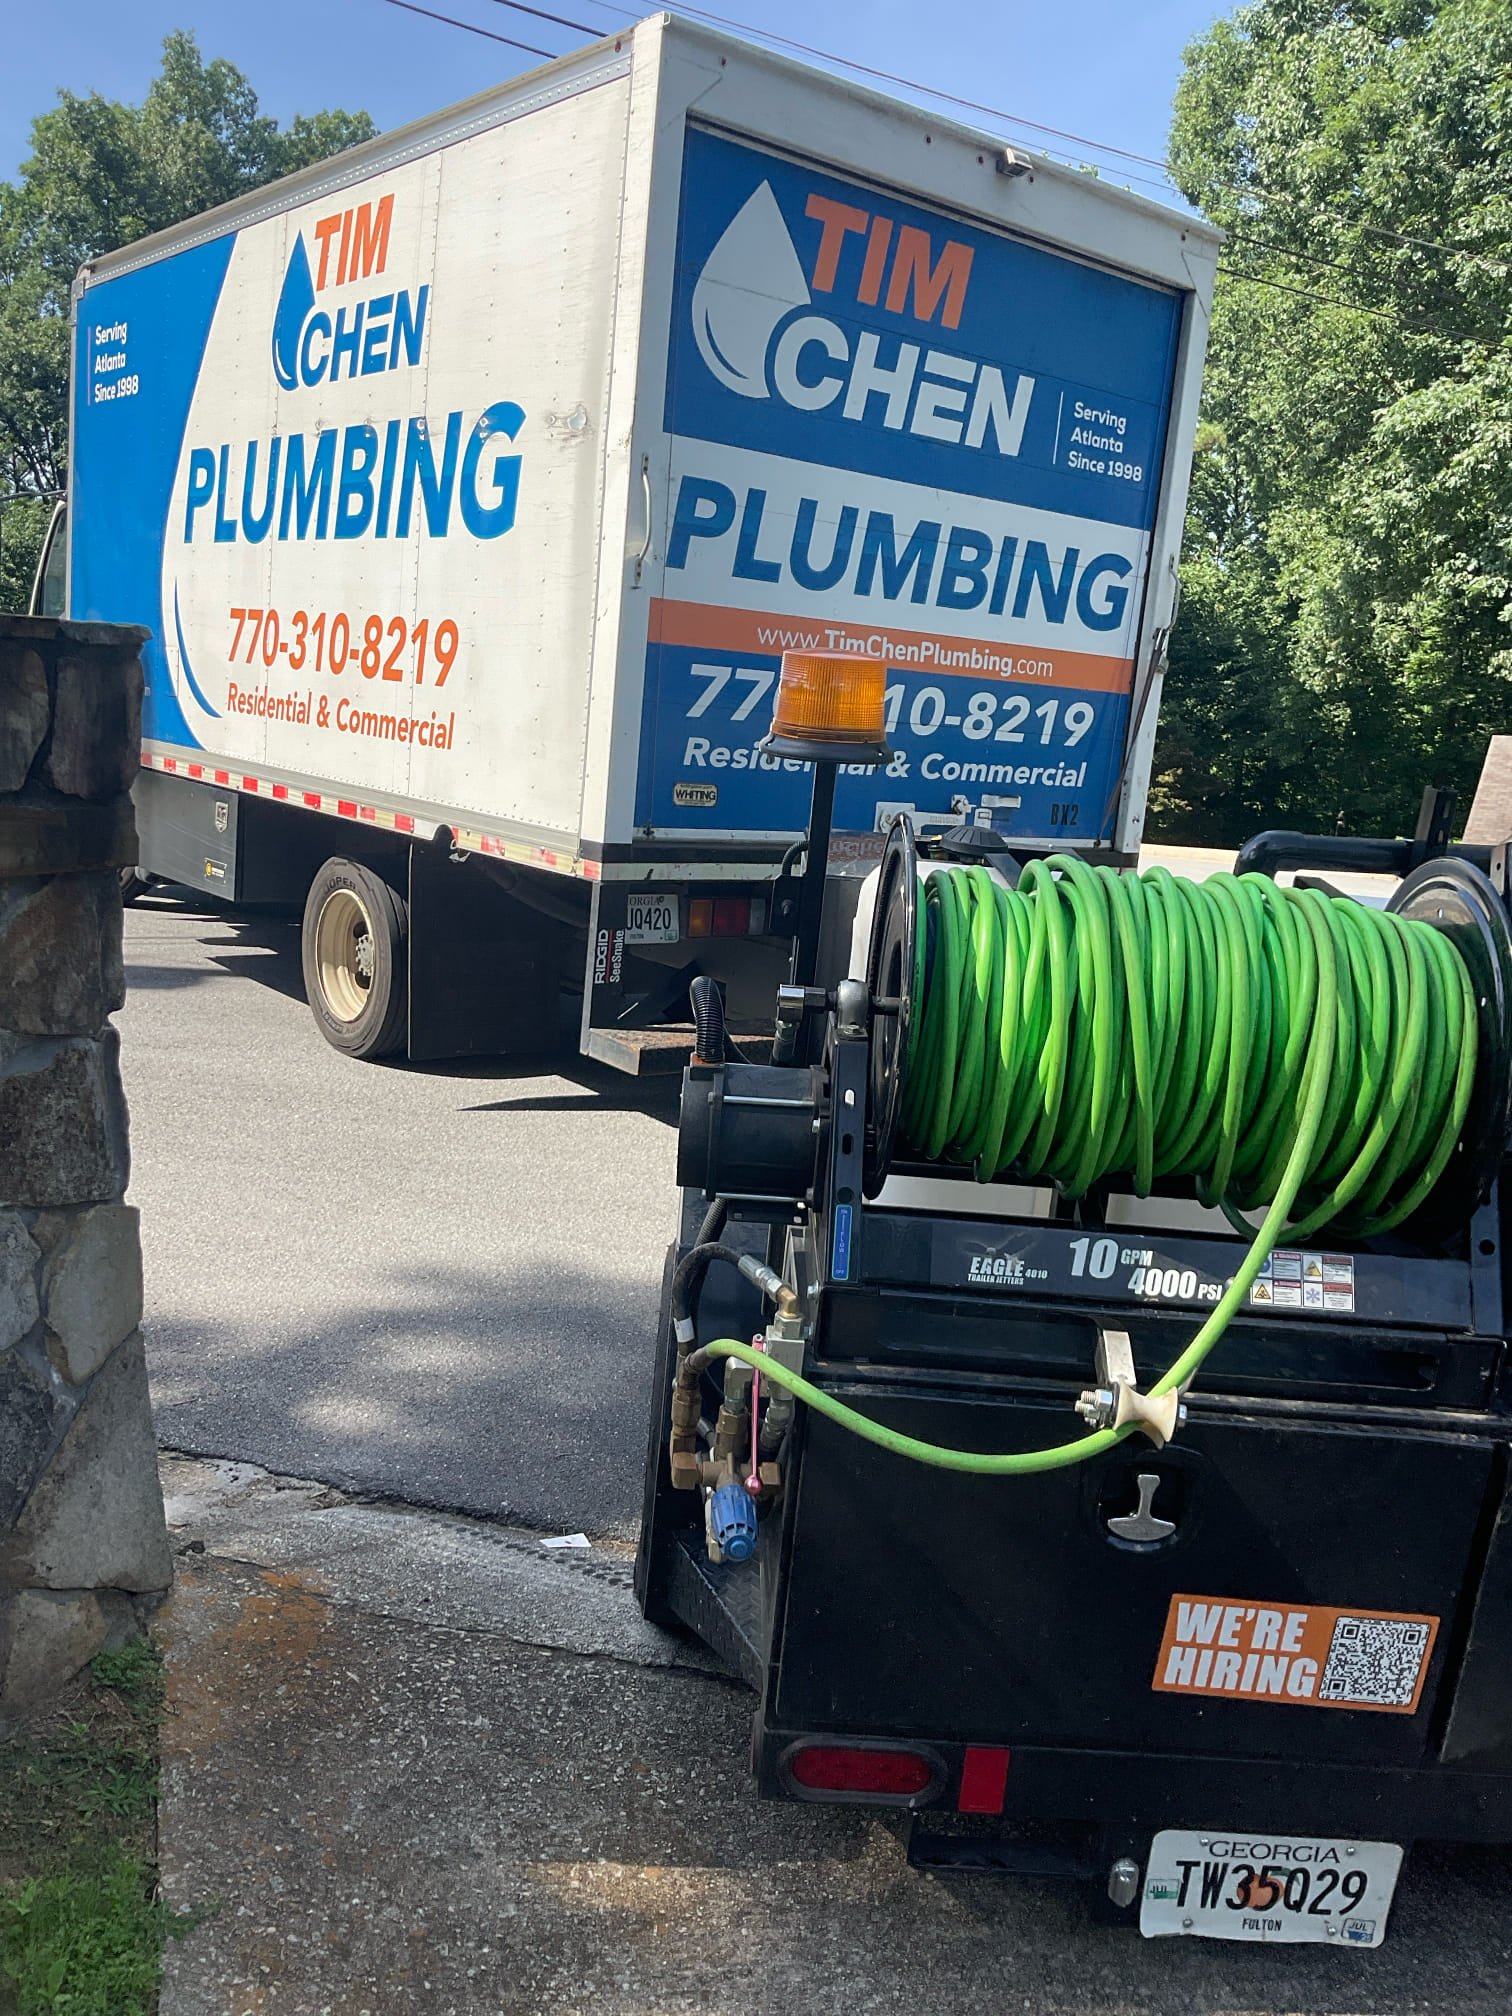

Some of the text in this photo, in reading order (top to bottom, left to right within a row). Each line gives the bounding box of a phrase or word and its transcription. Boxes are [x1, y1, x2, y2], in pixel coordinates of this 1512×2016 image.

[314, 193, 395, 291] TIM
[804, 193, 975, 329] TIM
[95, 321, 127, 345] Serving
[302, 284, 430, 387] CHEN
[94, 352, 126, 374] Atlanta
[774, 316, 1036, 457] CHEN
[94, 374, 139, 403] Since 1998
[1070, 427, 1124, 453] Atlanta
[1074, 401, 1127, 435] Serving
[183, 401, 527, 544] PLUMBING
[1067, 450, 1143, 482] Since 1998
[666, 475, 1133, 631] PLUMBING
[228, 608, 459, 687] 770-310-8219
[757, 626, 1053, 678] wwwTimChenPlumbing.com
[227, 682, 455, 750] Residential & Commercial
[685, 663, 1096, 747] 7710-8219
[885, 750, 911, 778] &
[921, 753, 1087, 788] Commercial
[675, 789, 716, 801] WHITING
[595, 929, 609, 984] RIDGID
[610, 930, 625, 983] SeeSnake
[968, 1273, 1024, 1286] TRAILER JETTERS
[970, 1256, 1048, 1279] EAGLE 4010
[1069, 1237, 1153, 1279] 10 GPM
[1127, 1267, 1223, 1300] 4000 PSI
[1176, 1602, 1308, 1652] WE'RE
[1164, 1646, 1319, 1698] HIRING
[1209, 1840, 1341, 1863] GEORGIA
[1176, 1860, 1368, 1916] TW35Q29
[1241, 1918, 1283, 1932] FULTON
